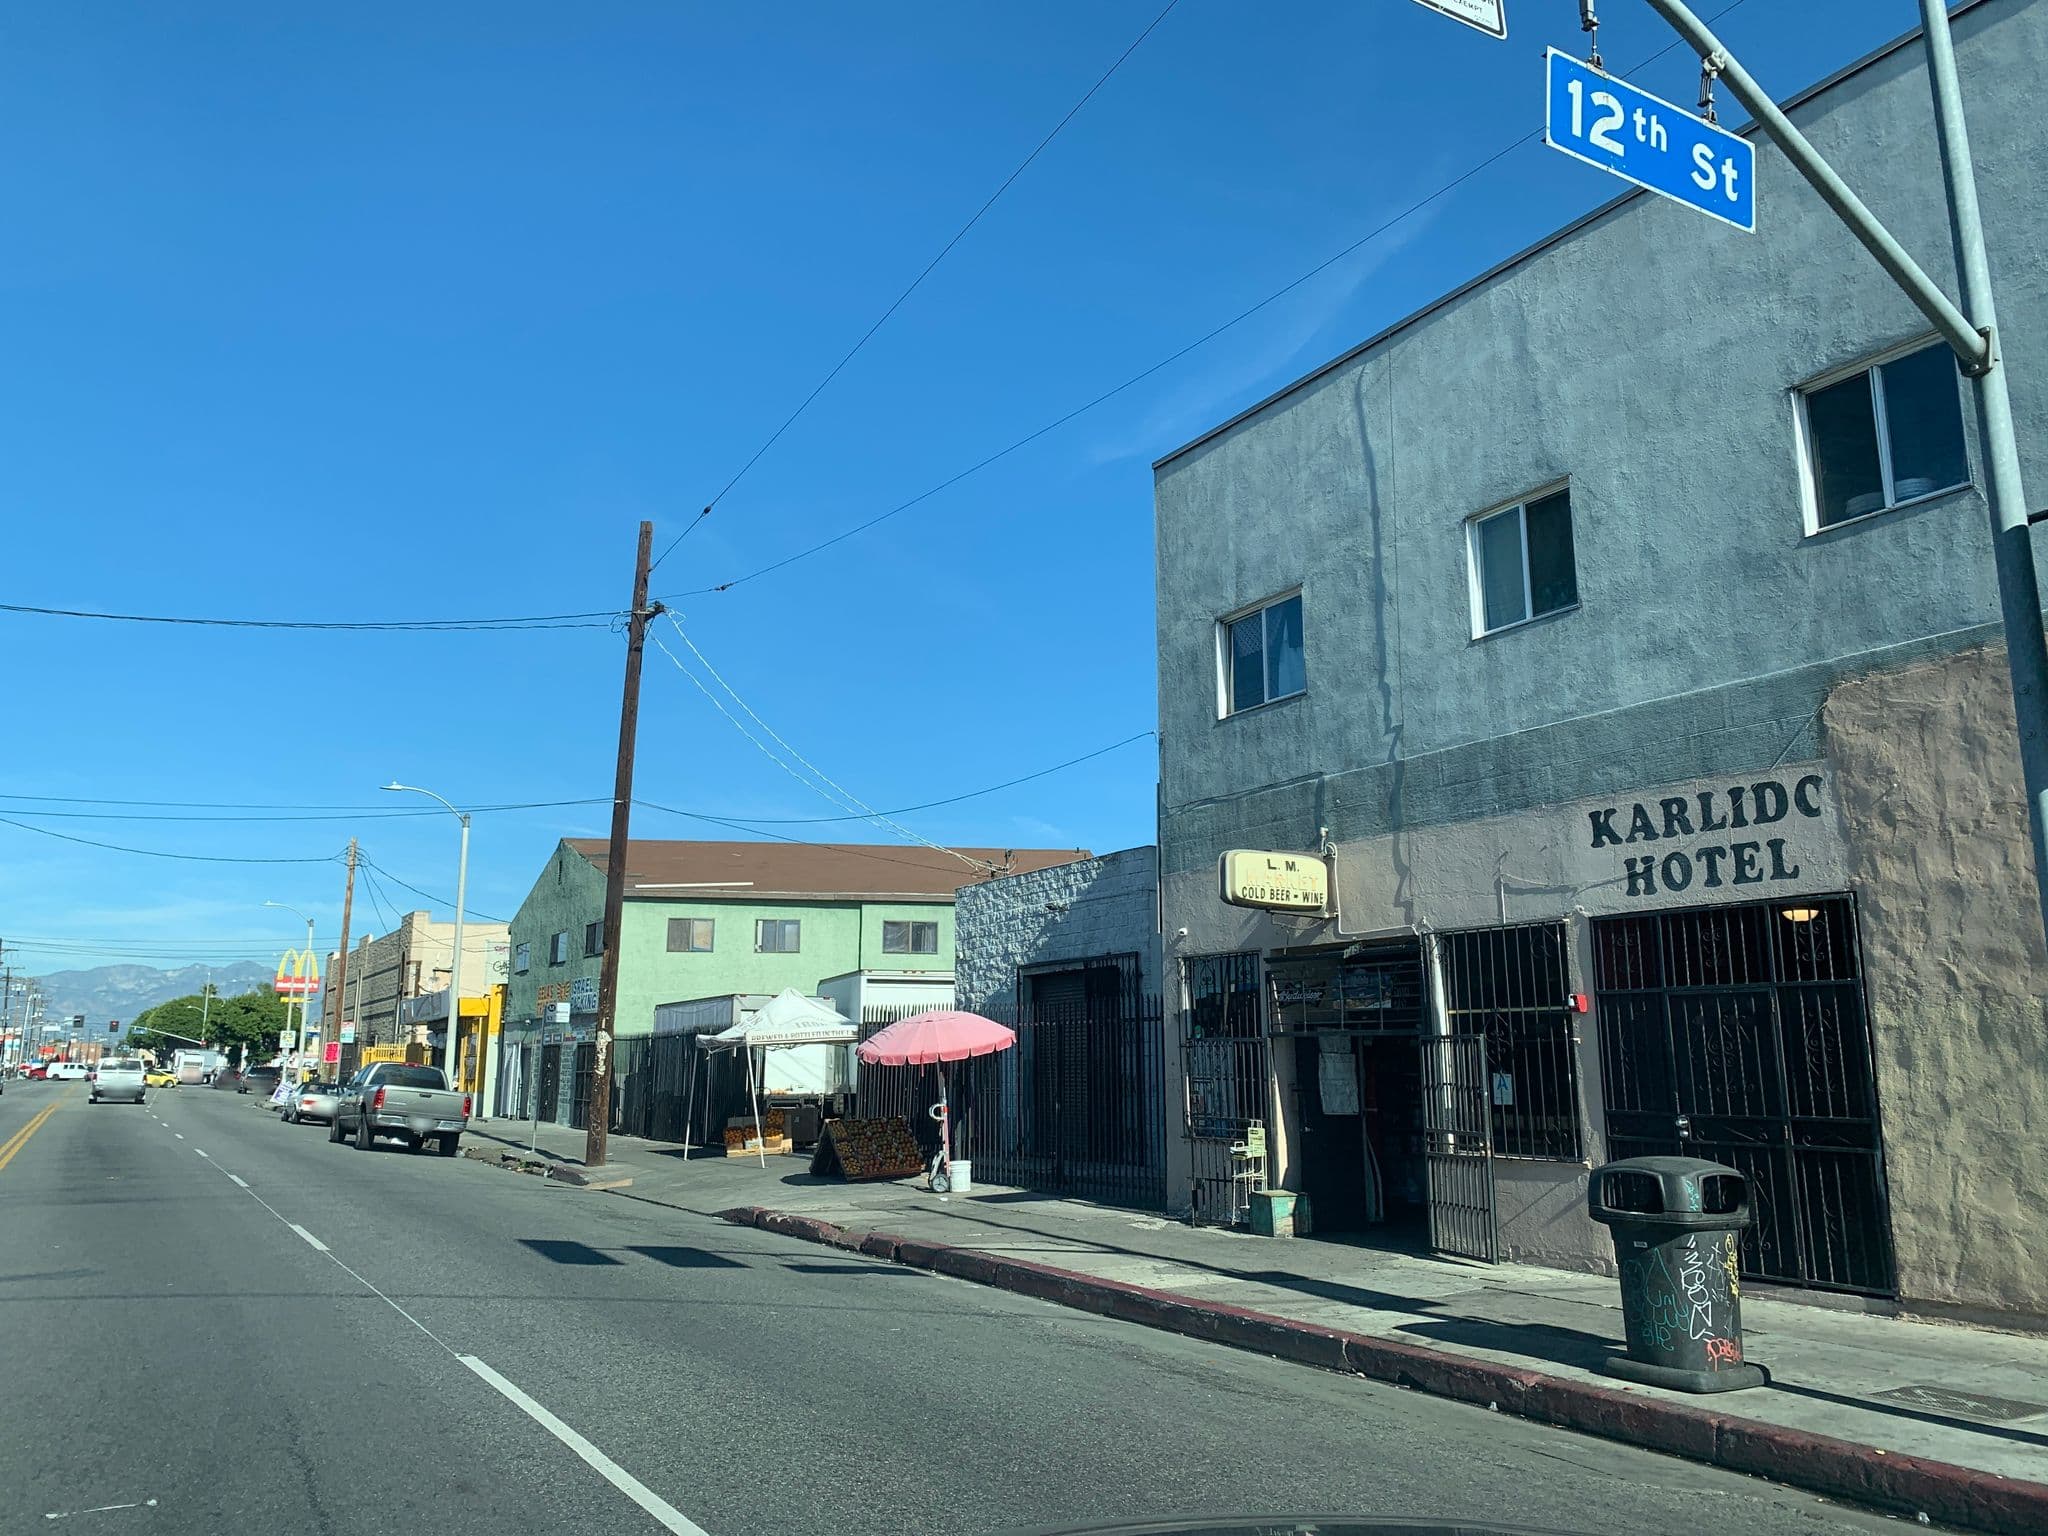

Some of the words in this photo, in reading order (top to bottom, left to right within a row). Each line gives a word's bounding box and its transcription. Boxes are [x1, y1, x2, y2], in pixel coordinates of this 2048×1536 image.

[1567, 79, 1668, 157] 12th
[1690, 142, 1740, 202] St
[1588, 774, 1824, 848] KARLIDC
[1241, 886, 1266, 900] COLD
[1269, 888, 1291, 902] BEER
[1302, 891, 1324, 904] WINE
[1623, 838, 1800, 897] HOTEL
[1497, 1074, 1508, 1090] A
